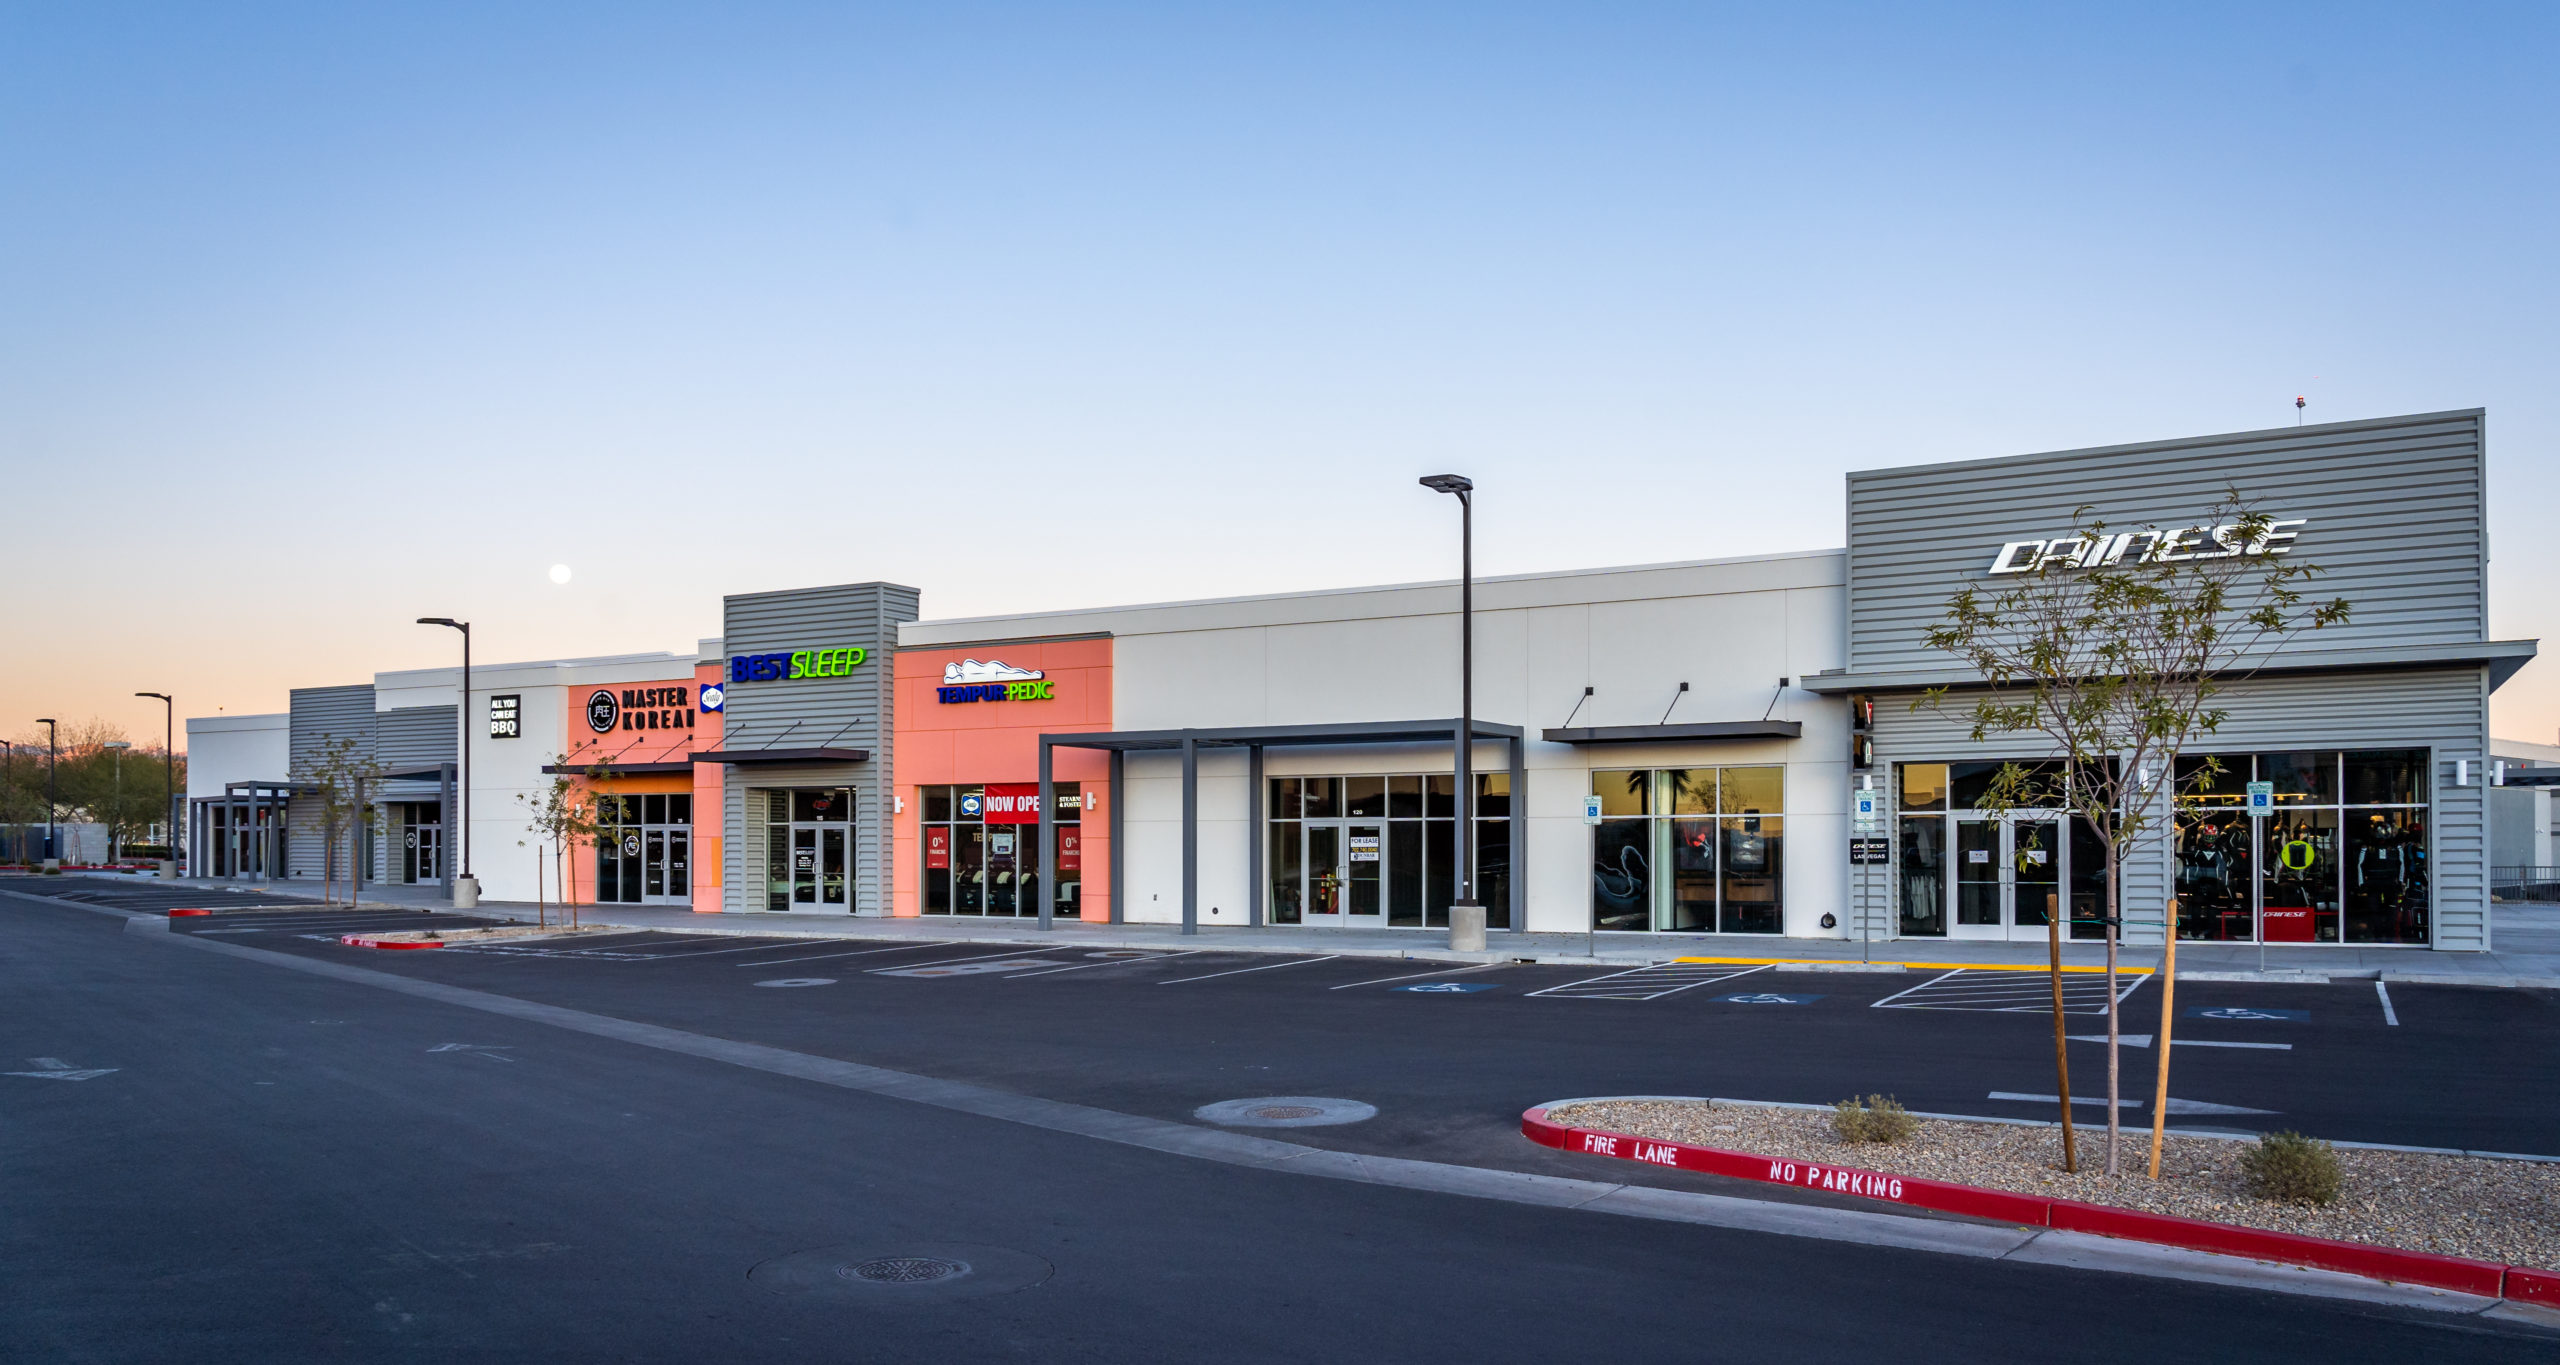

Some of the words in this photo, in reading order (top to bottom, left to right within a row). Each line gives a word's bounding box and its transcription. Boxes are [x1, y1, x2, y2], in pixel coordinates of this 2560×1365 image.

[1988, 518, 2308, 575] DAINESE
[622, 687, 687, 709] MASTER
[937, 682, 1054, 704] TEMPUR-PEDIC
[491, 700, 503, 709] ALL
[503, 699, 517, 708] YOU
[491, 711, 504, 719] CAN
[504, 710, 517, 719] EAT
[491, 720, 517, 735] BBQ
[986, 796, 1014, 812] NOW
[1017, 795, 1040, 812] OPE
[932, 837, 944, 847] 0%
[1065, 837, 1077, 848] 0%
[1584, 1133, 1618, 1156] FIRE
[1634, 1141, 1678, 1166] LANE
[1770, 1161, 1796, 1182] NO
[1807, 1166, 1903, 1199] PARKING
